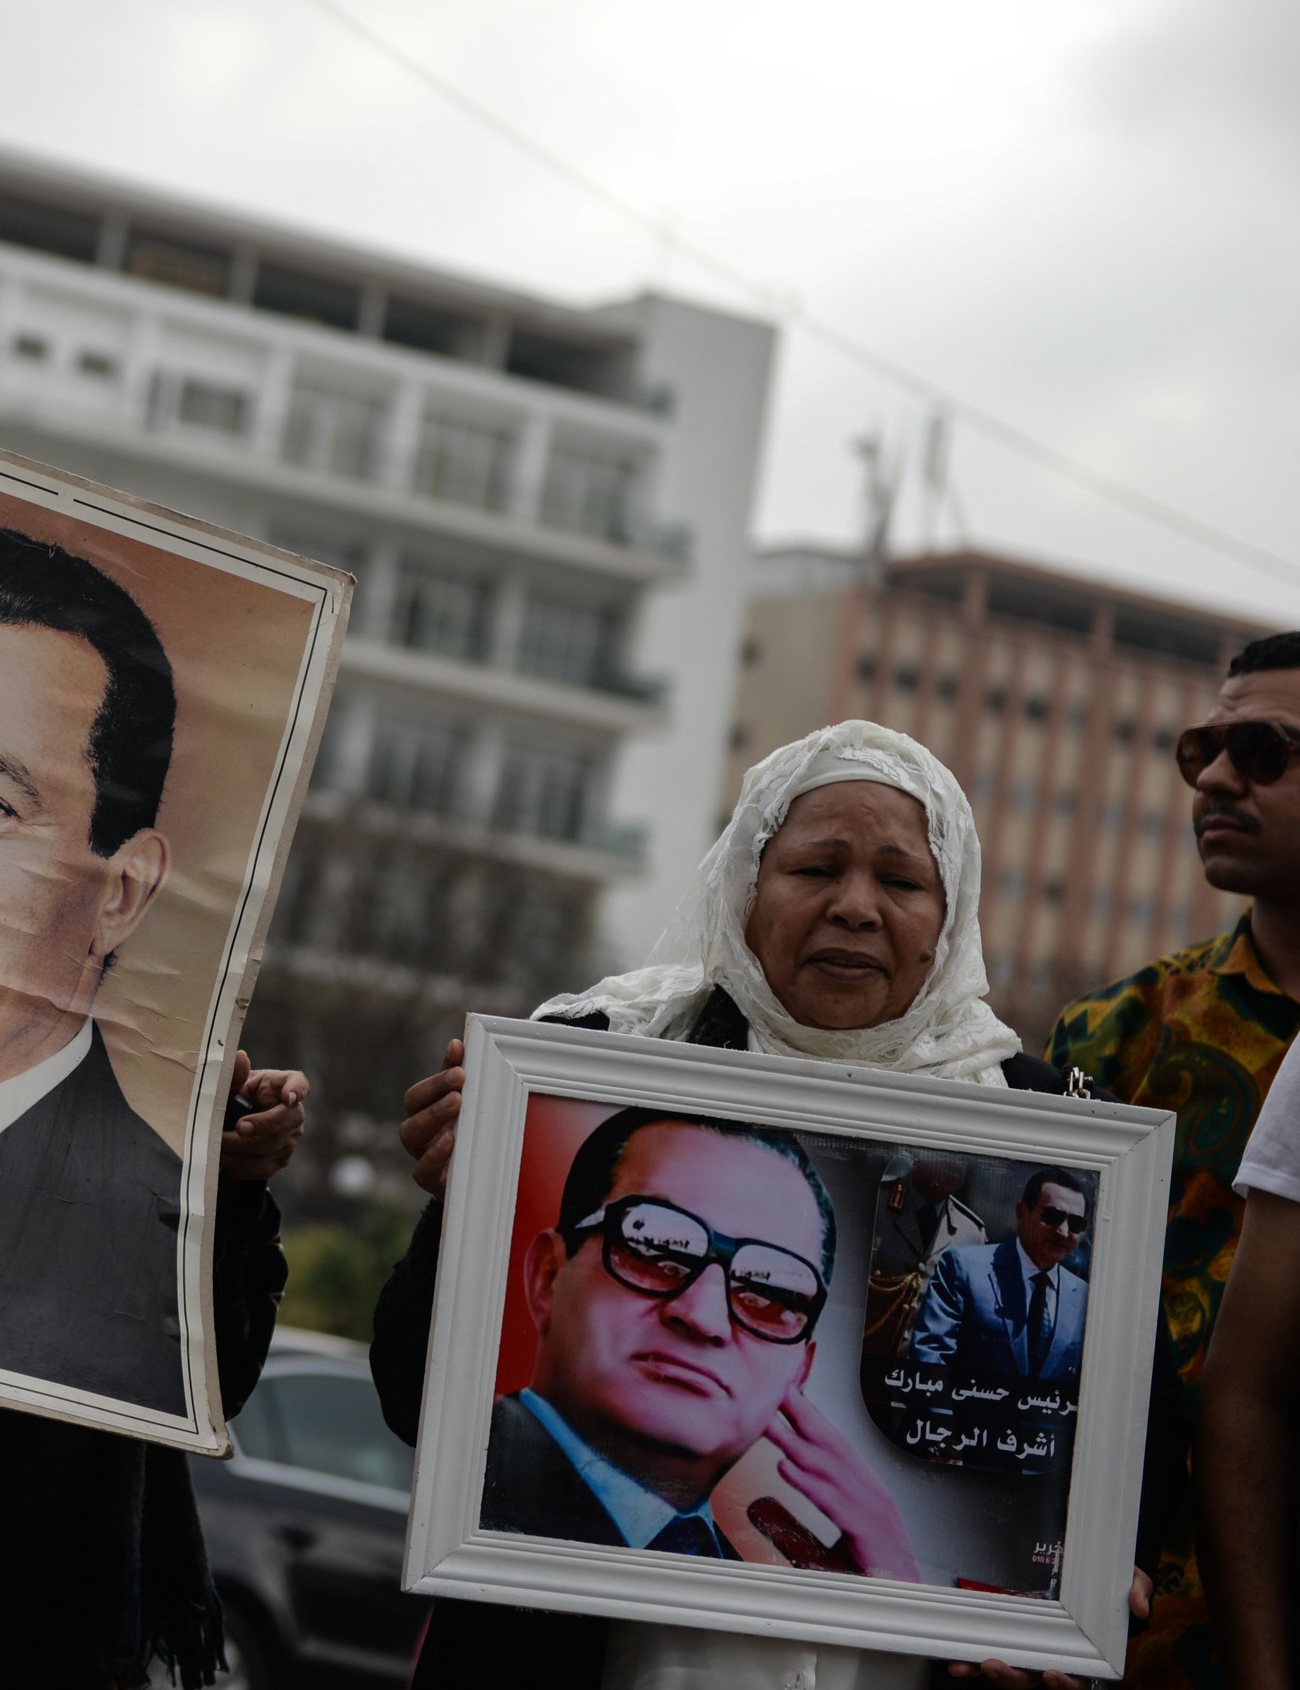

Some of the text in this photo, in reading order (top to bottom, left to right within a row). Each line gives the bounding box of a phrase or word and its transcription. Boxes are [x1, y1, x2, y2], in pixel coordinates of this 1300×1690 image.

[884, 1368, 944, 1397] مبارك
[1017, 1389, 1078, 1416] رئيس
[906, 1418, 1056, 1460] أشرف الرجال
